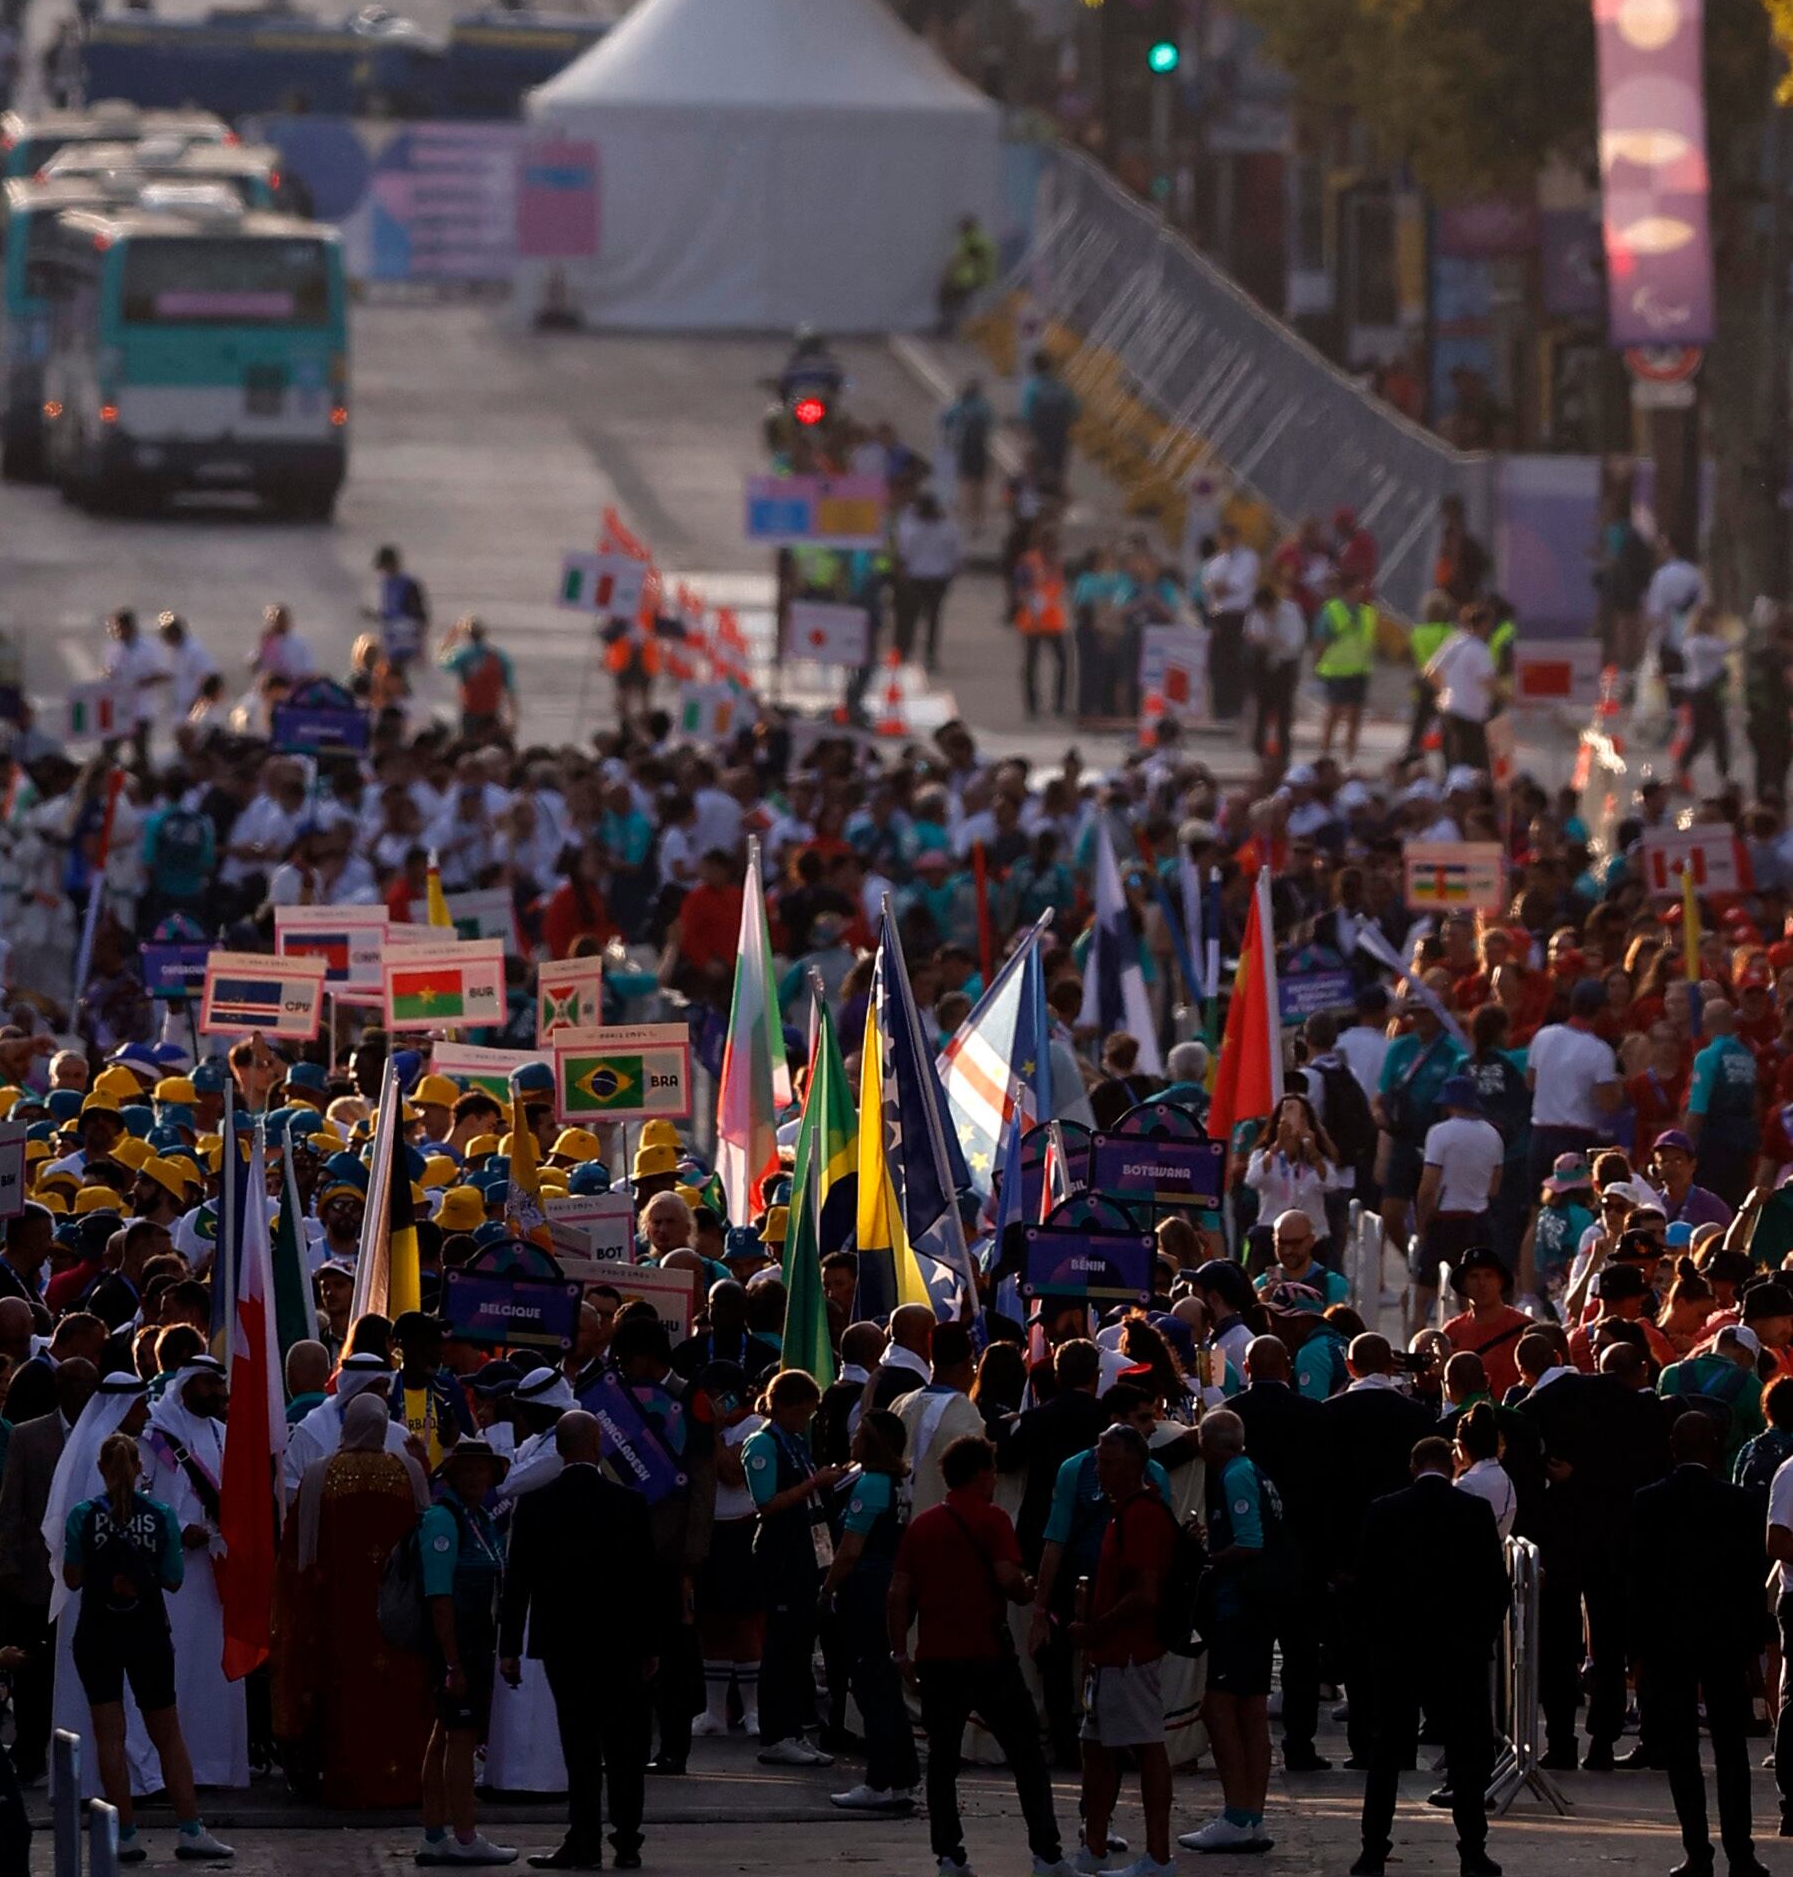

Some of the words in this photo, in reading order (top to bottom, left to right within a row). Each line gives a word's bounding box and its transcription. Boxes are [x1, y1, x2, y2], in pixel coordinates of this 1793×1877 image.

[469, 986, 494, 998] BUR
[651, 1074, 678, 1087] BRA
[1122, 1164, 1191, 1179] BOTSWANA
[596, 1246, 623, 1260] BOT
[1070, 1254, 1106, 1272] BÉNIN
[479, 1302, 541, 1319] BELGIQUE
[595, 1408, 652, 1482] BANGLADESH
